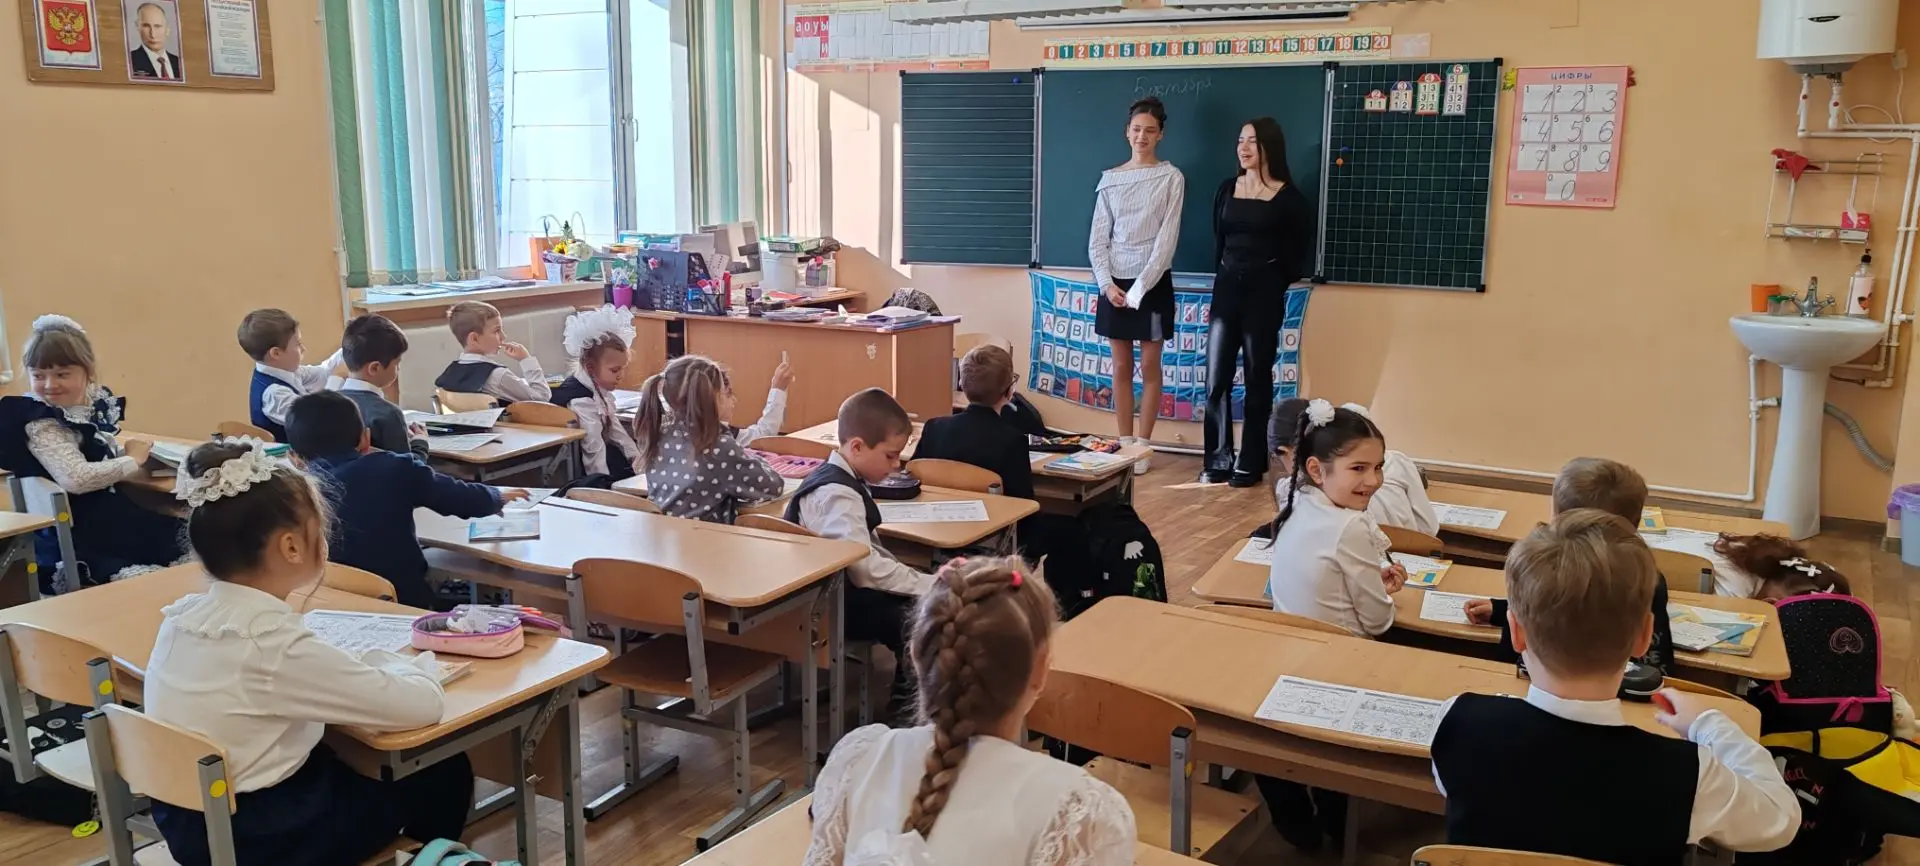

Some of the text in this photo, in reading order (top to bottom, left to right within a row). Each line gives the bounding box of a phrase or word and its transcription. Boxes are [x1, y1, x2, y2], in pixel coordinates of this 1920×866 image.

[1048, 36, 1388, 57] 0 1 2 3 4 5 6 7 8 9 10 11 12 13 14 15 16 17 18 19 20
[1551, 72, 1593, 81] ЦИФРЫ
[1556, 85, 1562, 93] 2
[1570, 90, 1586, 113] 2
[1588, 85, 1594, 93] 3
[1601, 89, 1618, 113] 3
[1537, 120, 1550, 144] 4
[1554, 115, 1559, 123] 5
[1567, 120, 1583, 143] 5
[1585, 115, 1591, 123] 6
[1599, 120, 1615, 143] 6
[1535, 149, 1548, 171] 7
[1551, 144, 1556, 152] 8
[1563, 150, 1579, 172] 8
[1582, 144, 1588, 152] 9
[1596, 150, 1611, 172] 9
[1058, 290, 1069, 304] 7
[1076, 296, 1082, 311] 1
